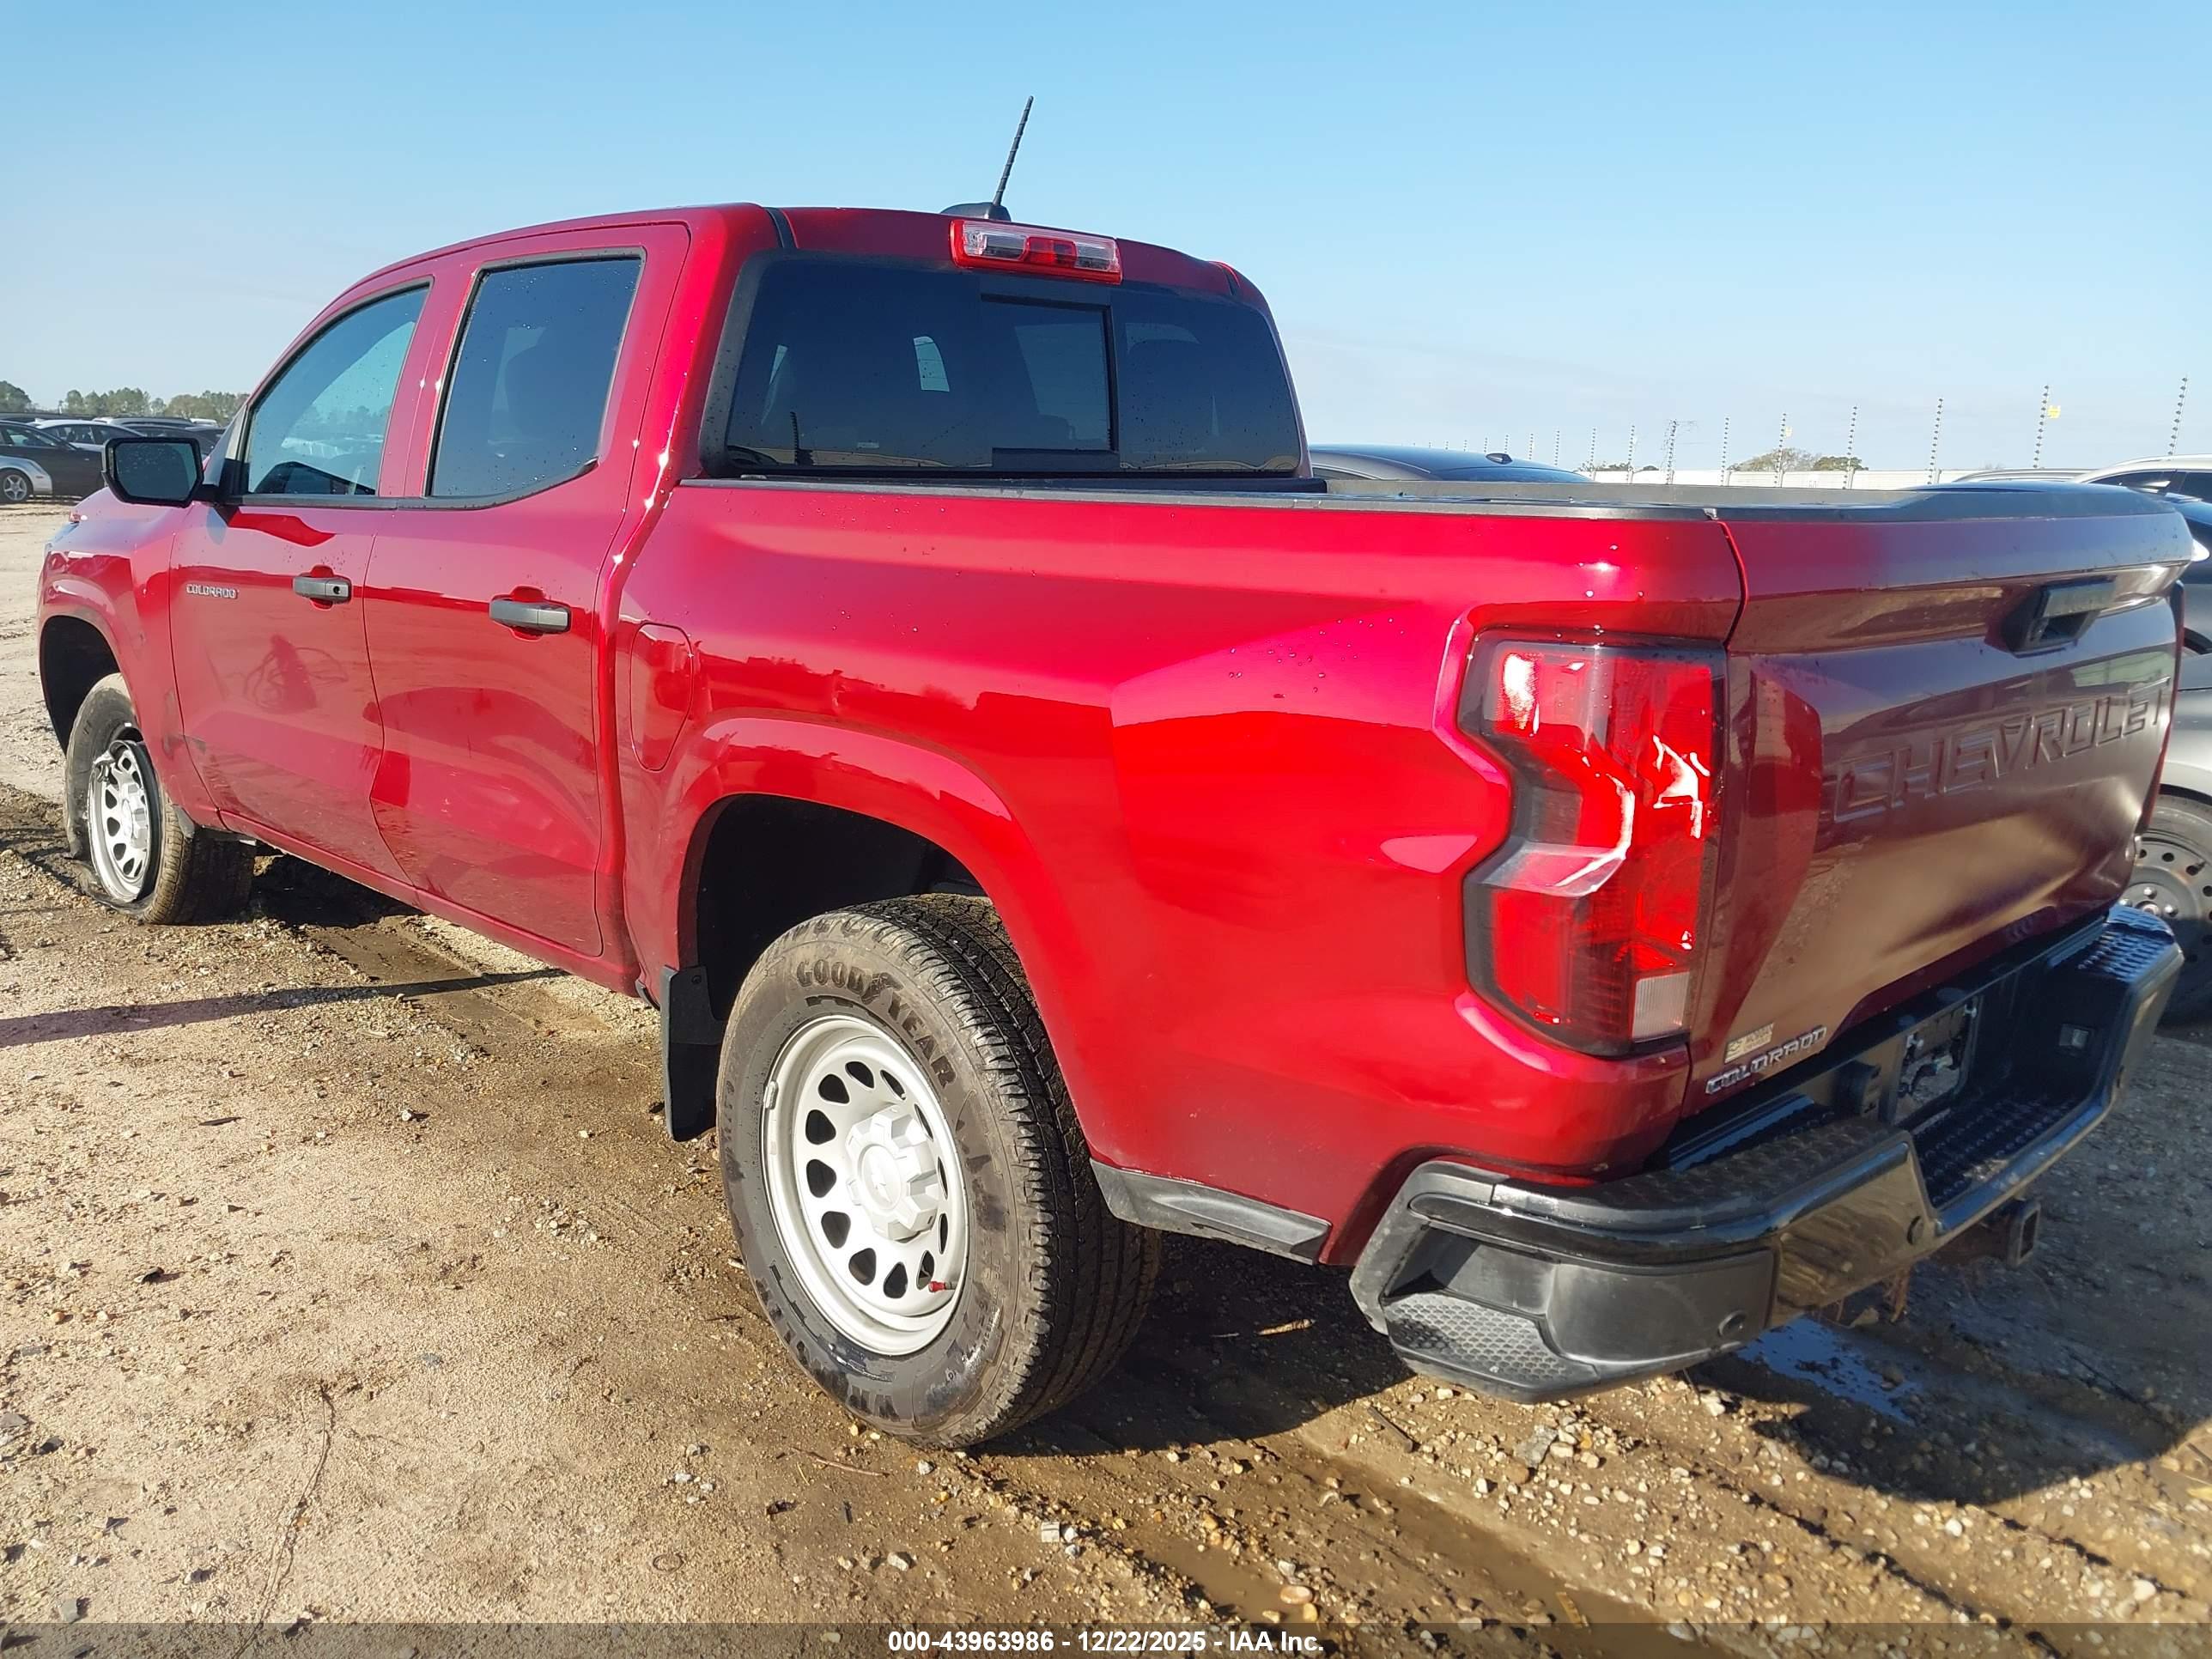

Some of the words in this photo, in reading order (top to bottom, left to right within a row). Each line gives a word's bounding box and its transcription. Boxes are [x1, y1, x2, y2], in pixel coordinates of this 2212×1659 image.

[186, 583, 238, 599] COLORADO
[1833, 676, 2171, 823] CHEVROLET
[796, 959, 957, 1089] GOODYEAR
[1705, 1026, 1828, 1095] COLORADO
